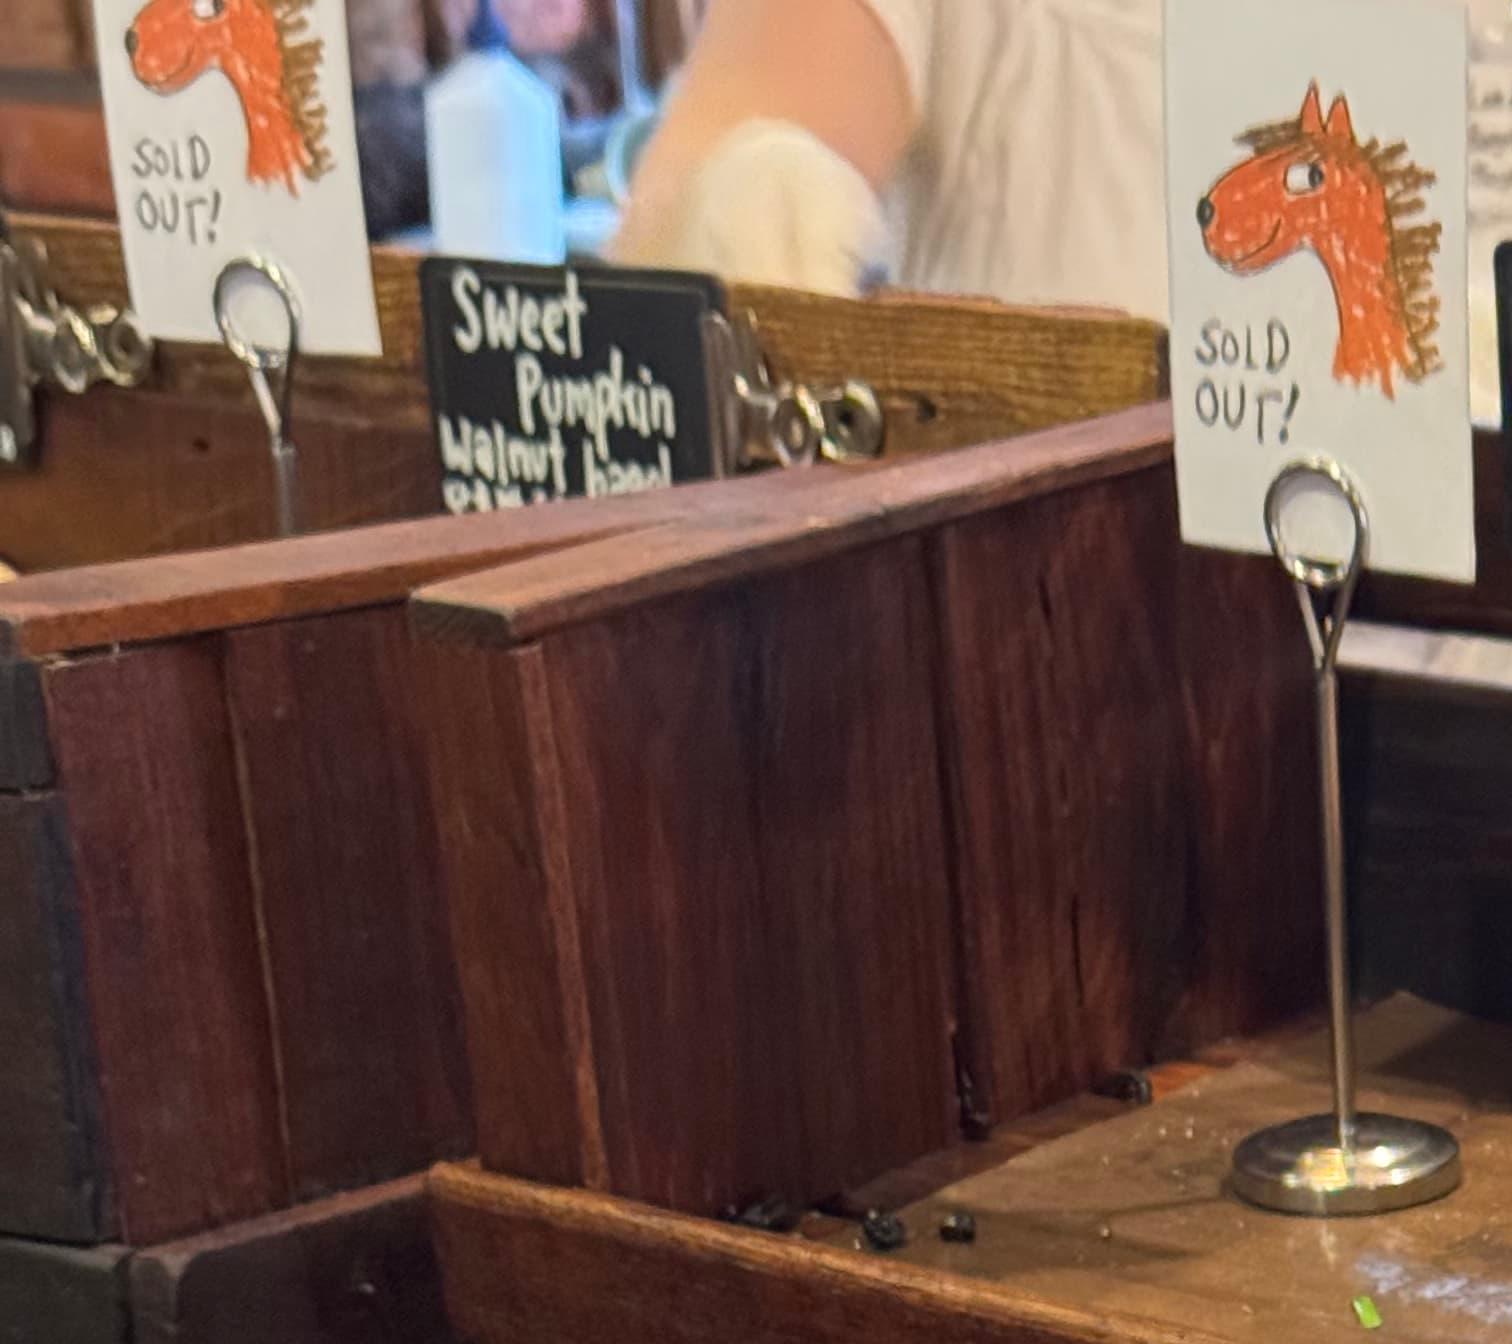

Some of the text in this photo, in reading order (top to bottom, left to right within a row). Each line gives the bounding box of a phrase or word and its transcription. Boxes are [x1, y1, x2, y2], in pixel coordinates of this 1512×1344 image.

[131, 134, 211, 181] SOLD
[136, 189, 221, 245] OUT!
[452, 266, 588, 358] Sweet
[1194, 317, 1290, 374] SOLD
[516, 348, 677, 462] Pumpkin
[1194, 378, 1300, 445] OUT!
[439, 413, 567, 500] Walnut
